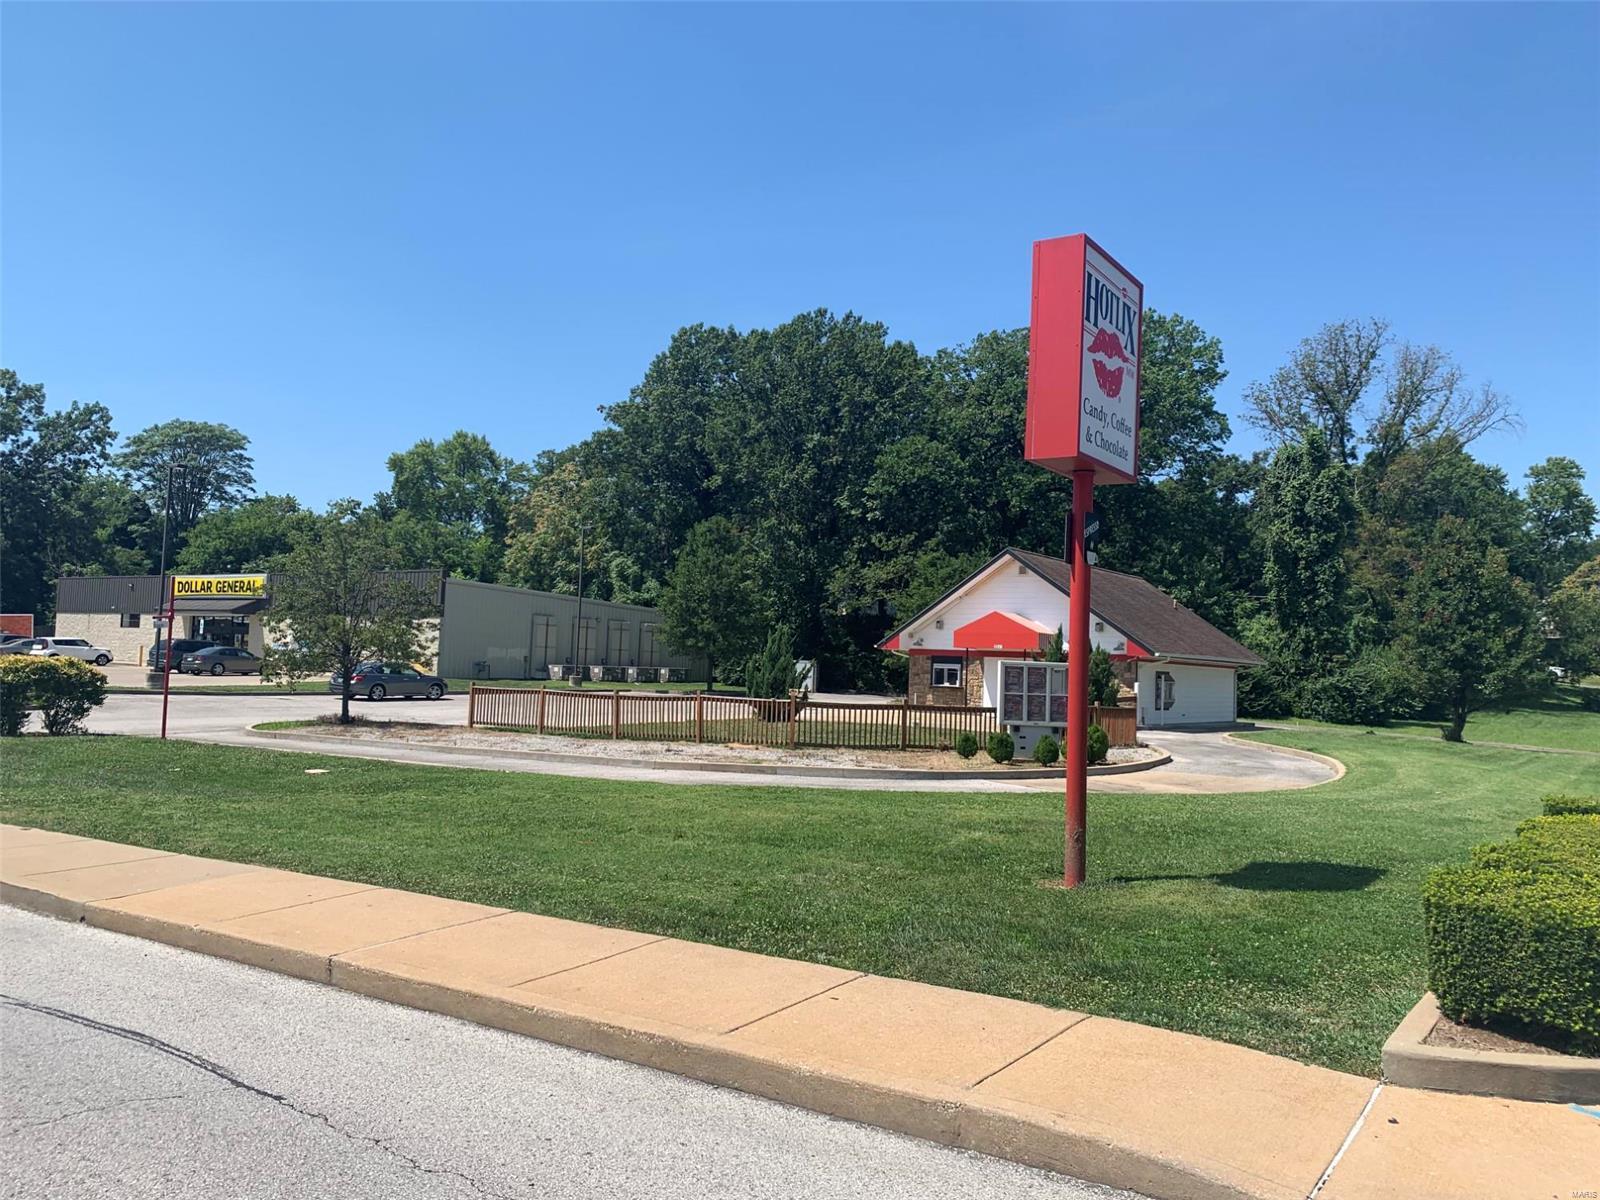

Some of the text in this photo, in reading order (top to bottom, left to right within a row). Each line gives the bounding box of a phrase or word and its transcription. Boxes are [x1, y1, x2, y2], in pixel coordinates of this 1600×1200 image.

[1085, 270, 1137, 358] HOTLIX
[1083, 397, 1132, 438] Candy, Coffee
[1086, 426, 1129, 461] & Chocolate
[177, 580, 213, 593] DOLLAR
